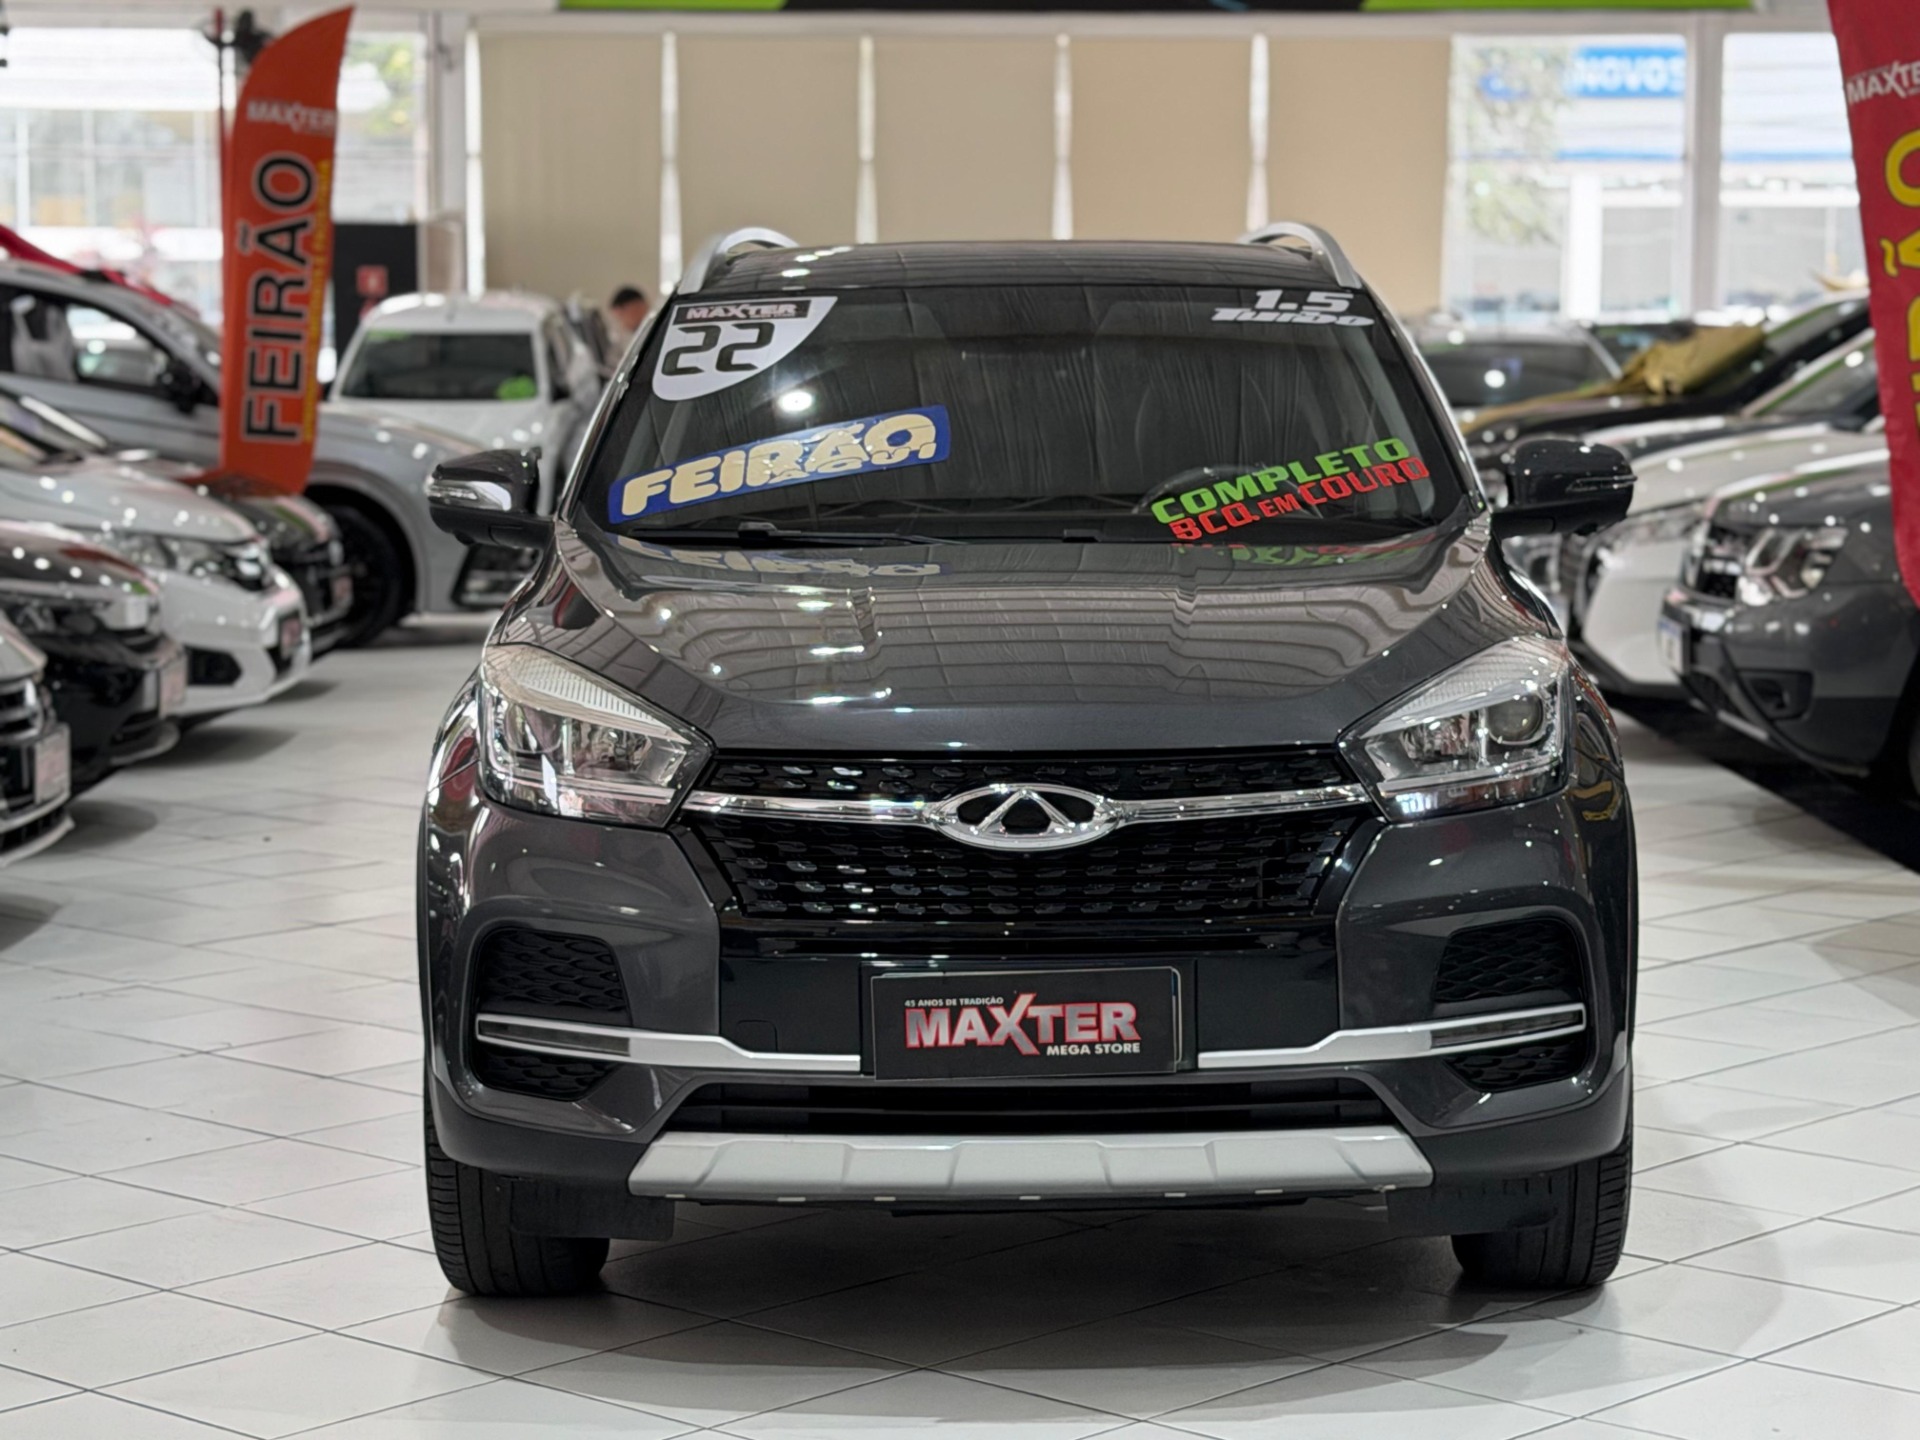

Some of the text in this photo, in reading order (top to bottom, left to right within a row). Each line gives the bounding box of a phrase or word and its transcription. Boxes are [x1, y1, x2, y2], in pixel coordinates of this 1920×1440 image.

[238, 152, 317, 441] FEIRÃO
[686, 303, 797, 319] MAXTER
[1255, 289, 1354, 312] 1.5
[661, 322, 775, 376] 22
[621, 414, 937, 516] FEIRÃO
[1151, 438, 1410, 524] COMPLETO
[1259, 493, 1301, 519] EM
[1297, 456, 1430, 506] COURO
[905, 993, 1141, 1055] MAXTER
[917, 998, 944, 1007] ANOS
[945, 998, 957, 1006] DE
[959, 996, 1004, 1006] TRADIÇÃO
[1046, 1042, 1140, 1056] MEGA STORE
